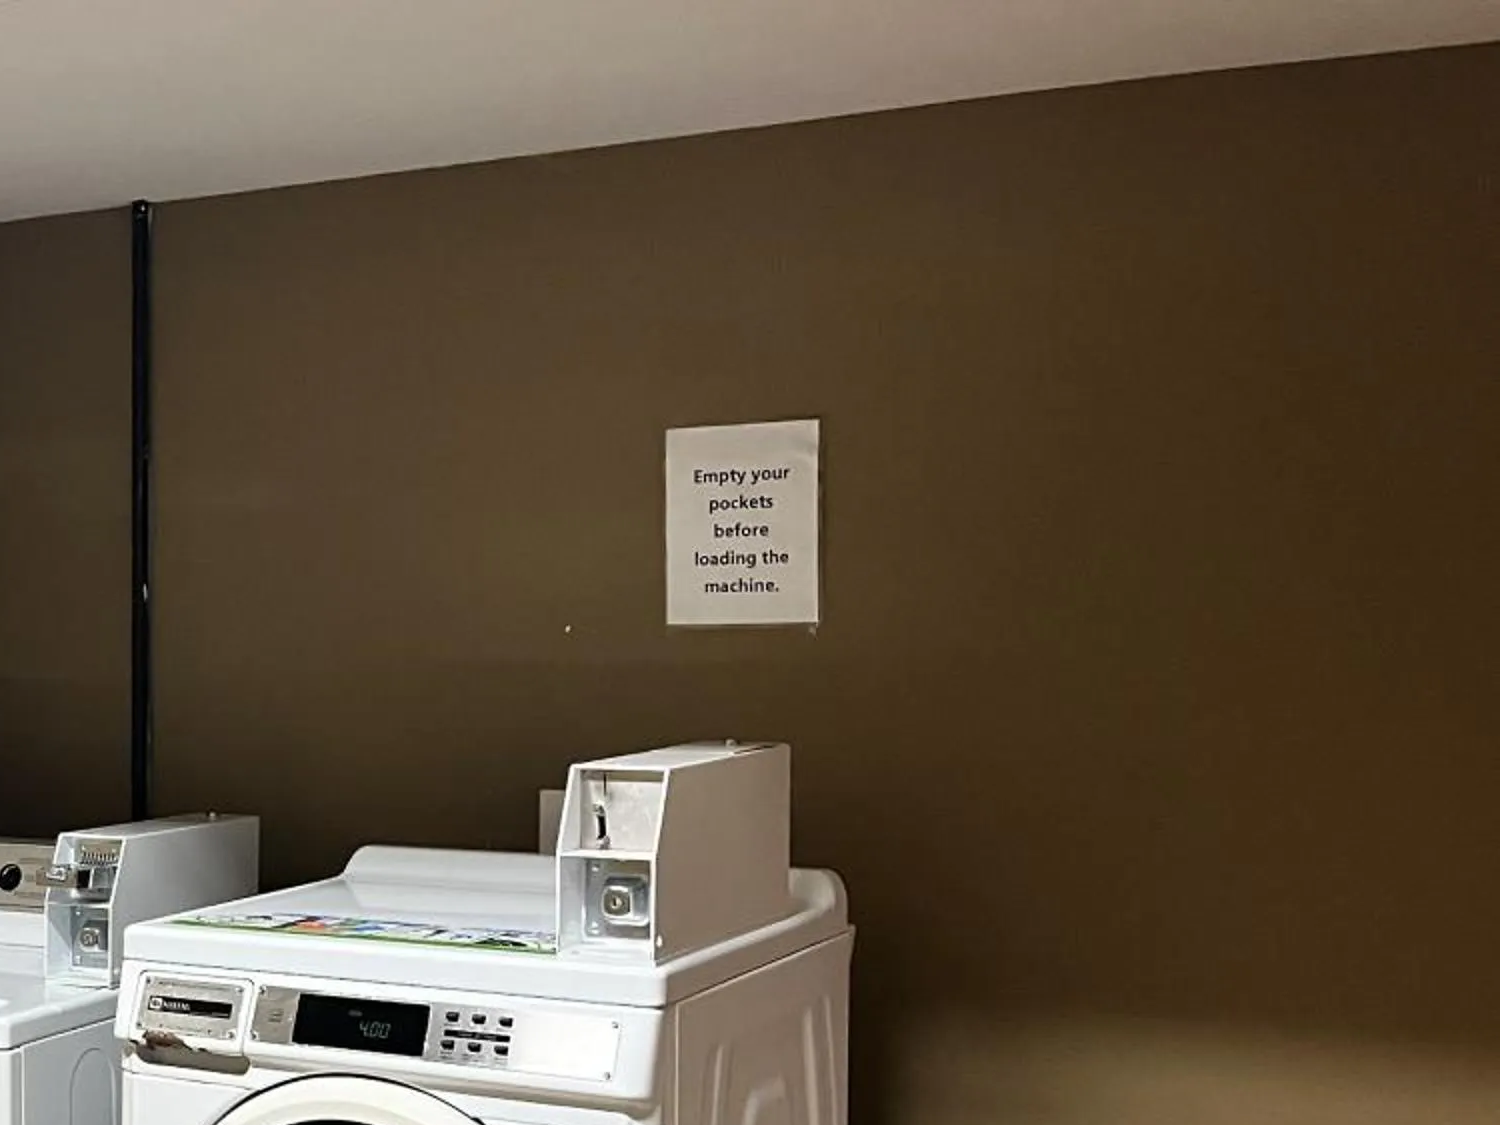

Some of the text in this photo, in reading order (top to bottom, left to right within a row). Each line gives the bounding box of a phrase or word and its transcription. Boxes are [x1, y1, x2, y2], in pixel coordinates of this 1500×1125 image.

[693, 467, 791, 486] Empty your
[709, 495, 773, 514] pockets
[713, 522, 769, 538] before
[694, 549, 789, 568] loading the
[704, 577, 780, 593] machine.
